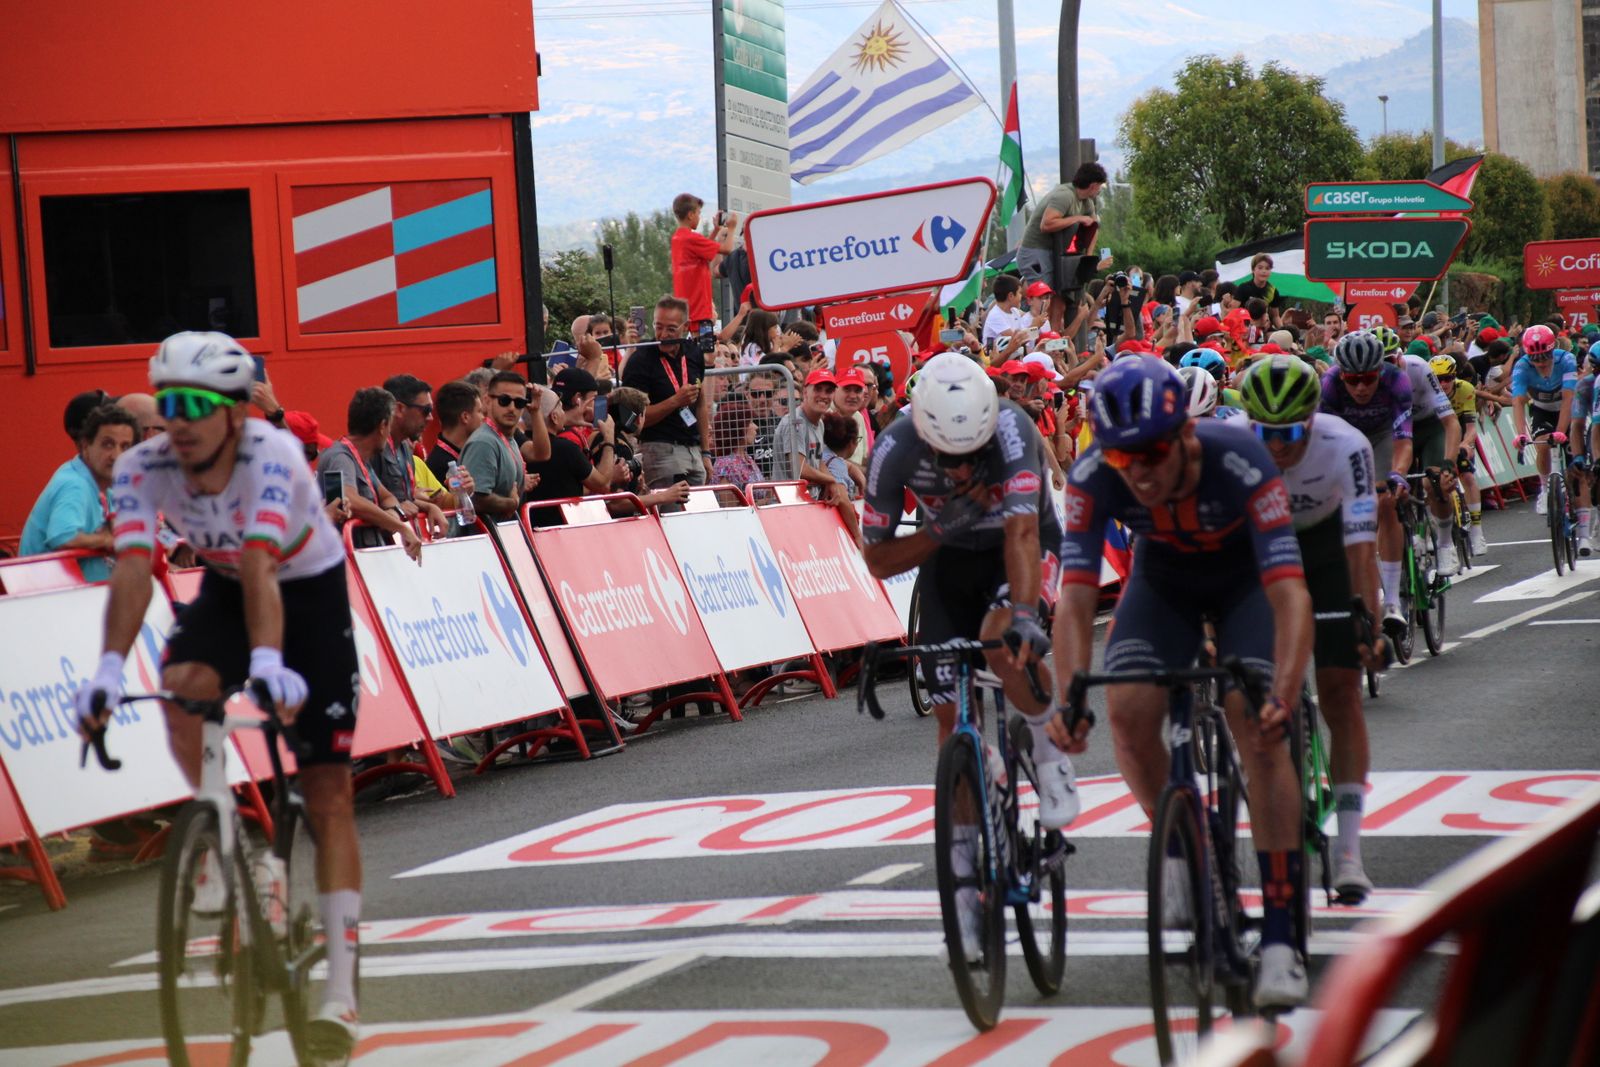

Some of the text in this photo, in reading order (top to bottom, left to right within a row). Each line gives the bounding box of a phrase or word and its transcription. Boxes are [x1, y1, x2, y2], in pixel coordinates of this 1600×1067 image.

[1324, 190, 1425, 205] caser Grupo Helvetia
[769, 235, 900, 272] Carrefour
[1350, 288, 1388, 297] Carrefour
[829, 309, 886, 328] Carrefour
[1569, 312, 1588, 327] 75
[853, 346, 891, 365] 25
[684, 554, 759, 615] Carrefour
[778, 543, 851, 600] Carrefour
[560, 570, 654, 637] Carrefour
[385, 596, 489, 669] Carrefour
[0, 656, 141, 750] arrefr
[508, 774, 1600, 862] COIIS
